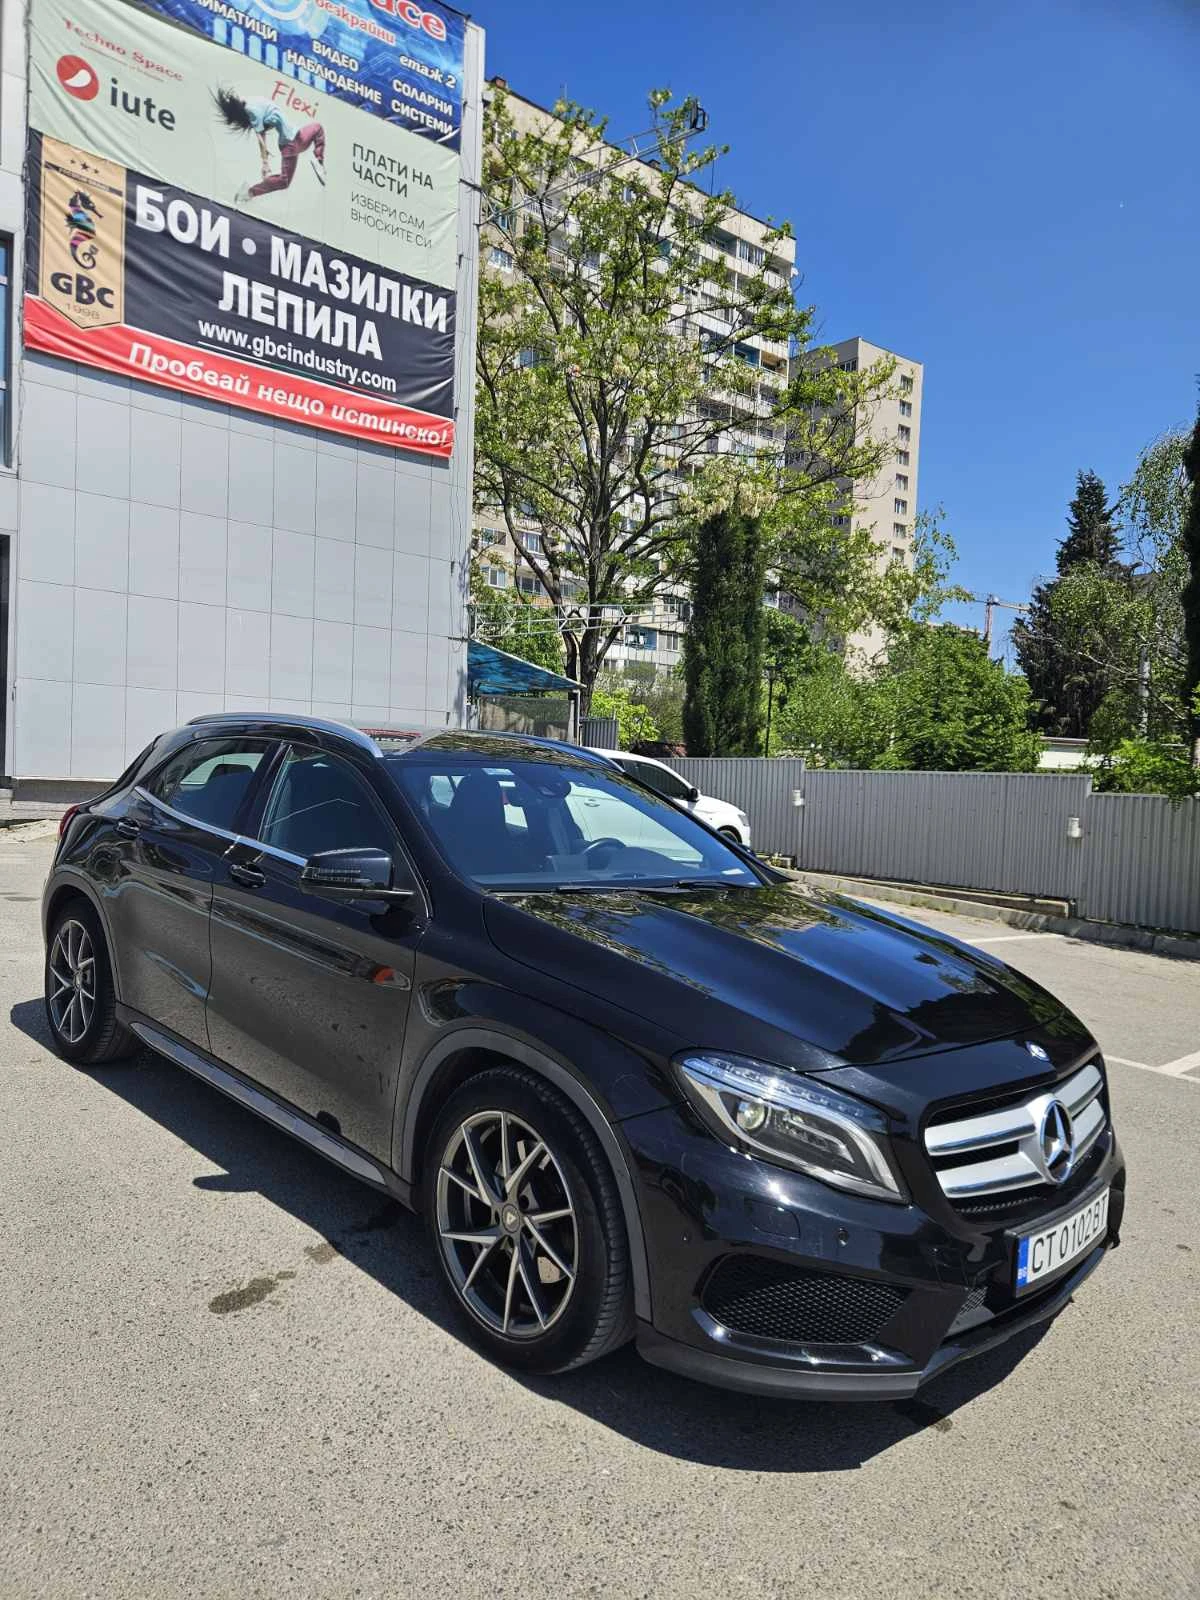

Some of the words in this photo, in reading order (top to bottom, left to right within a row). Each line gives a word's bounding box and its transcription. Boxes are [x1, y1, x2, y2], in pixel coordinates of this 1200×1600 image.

[132, 49, 183, 81] Space
[312, 40, 359, 72] ВИДЕО
[400, 55, 443, 84] етаж
[446, 75, 456, 89] 2
[287, 49, 382, 105] НАБЛЮДЕНИЕ
[111, 77, 175, 131] iute
[271, 80, 319, 118] Flexi
[392, 79, 453, 116] СОЛАРНИ
[391, 99, 453, 135] СИСТЕМИ
[352, 143, 408, 179] ПЛАТИ
[413, 168, 434, 190] НА
[352, 161, 408, 198] ЧАСТИ
[351, 191, 397, 219] ИЗБЕРИ
[399, 211, 425, 230] САМ
[351, 207, 413, 243] ВНОСКИТЕ
[135, 184, 230, 259] БОИ
[270, 235, 448, 334] МАЗИЛКИ
[51, 272, 114, 309] GBC
[218, 270, 383, 361] ЛЕПИЛА
[198, 320, 397, 393] www.gbcindustry.com
[128, 342, 250, 397] Пробвай
[257, 383, 324, 416] нещо
[331, 402, 448, 446] истинско!
